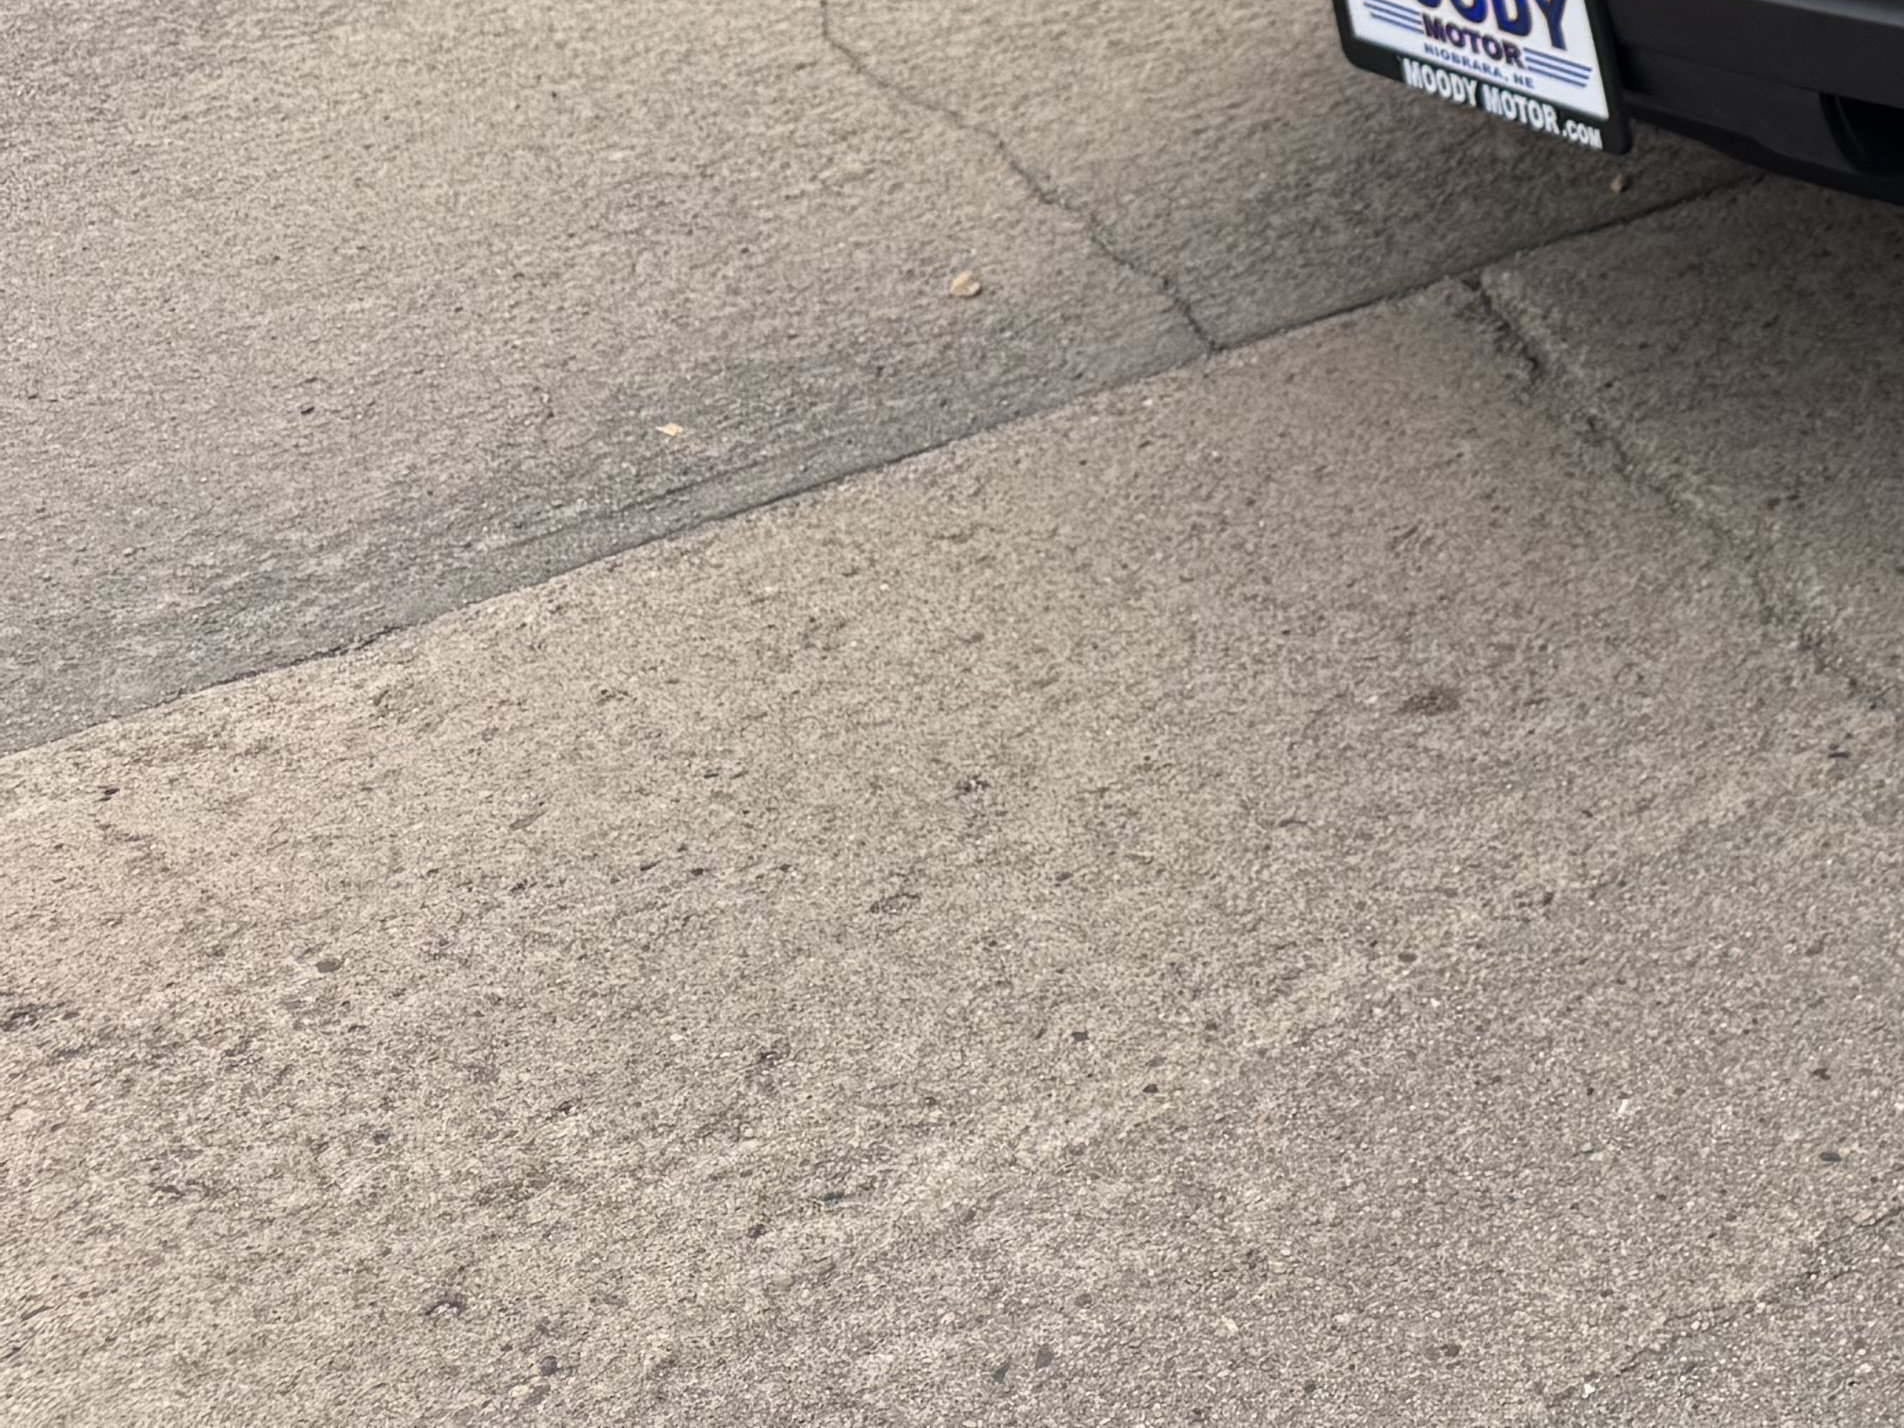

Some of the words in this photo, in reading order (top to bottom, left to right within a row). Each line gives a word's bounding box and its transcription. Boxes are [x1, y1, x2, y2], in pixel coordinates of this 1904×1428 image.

[1421, 12, 1526, 70] MOTOR
[1423, 42, 1509, 81] NIOBRARA,
[1512, 72, 1536, 90] NE
[1402, 57, 1479, 108] MOODY
